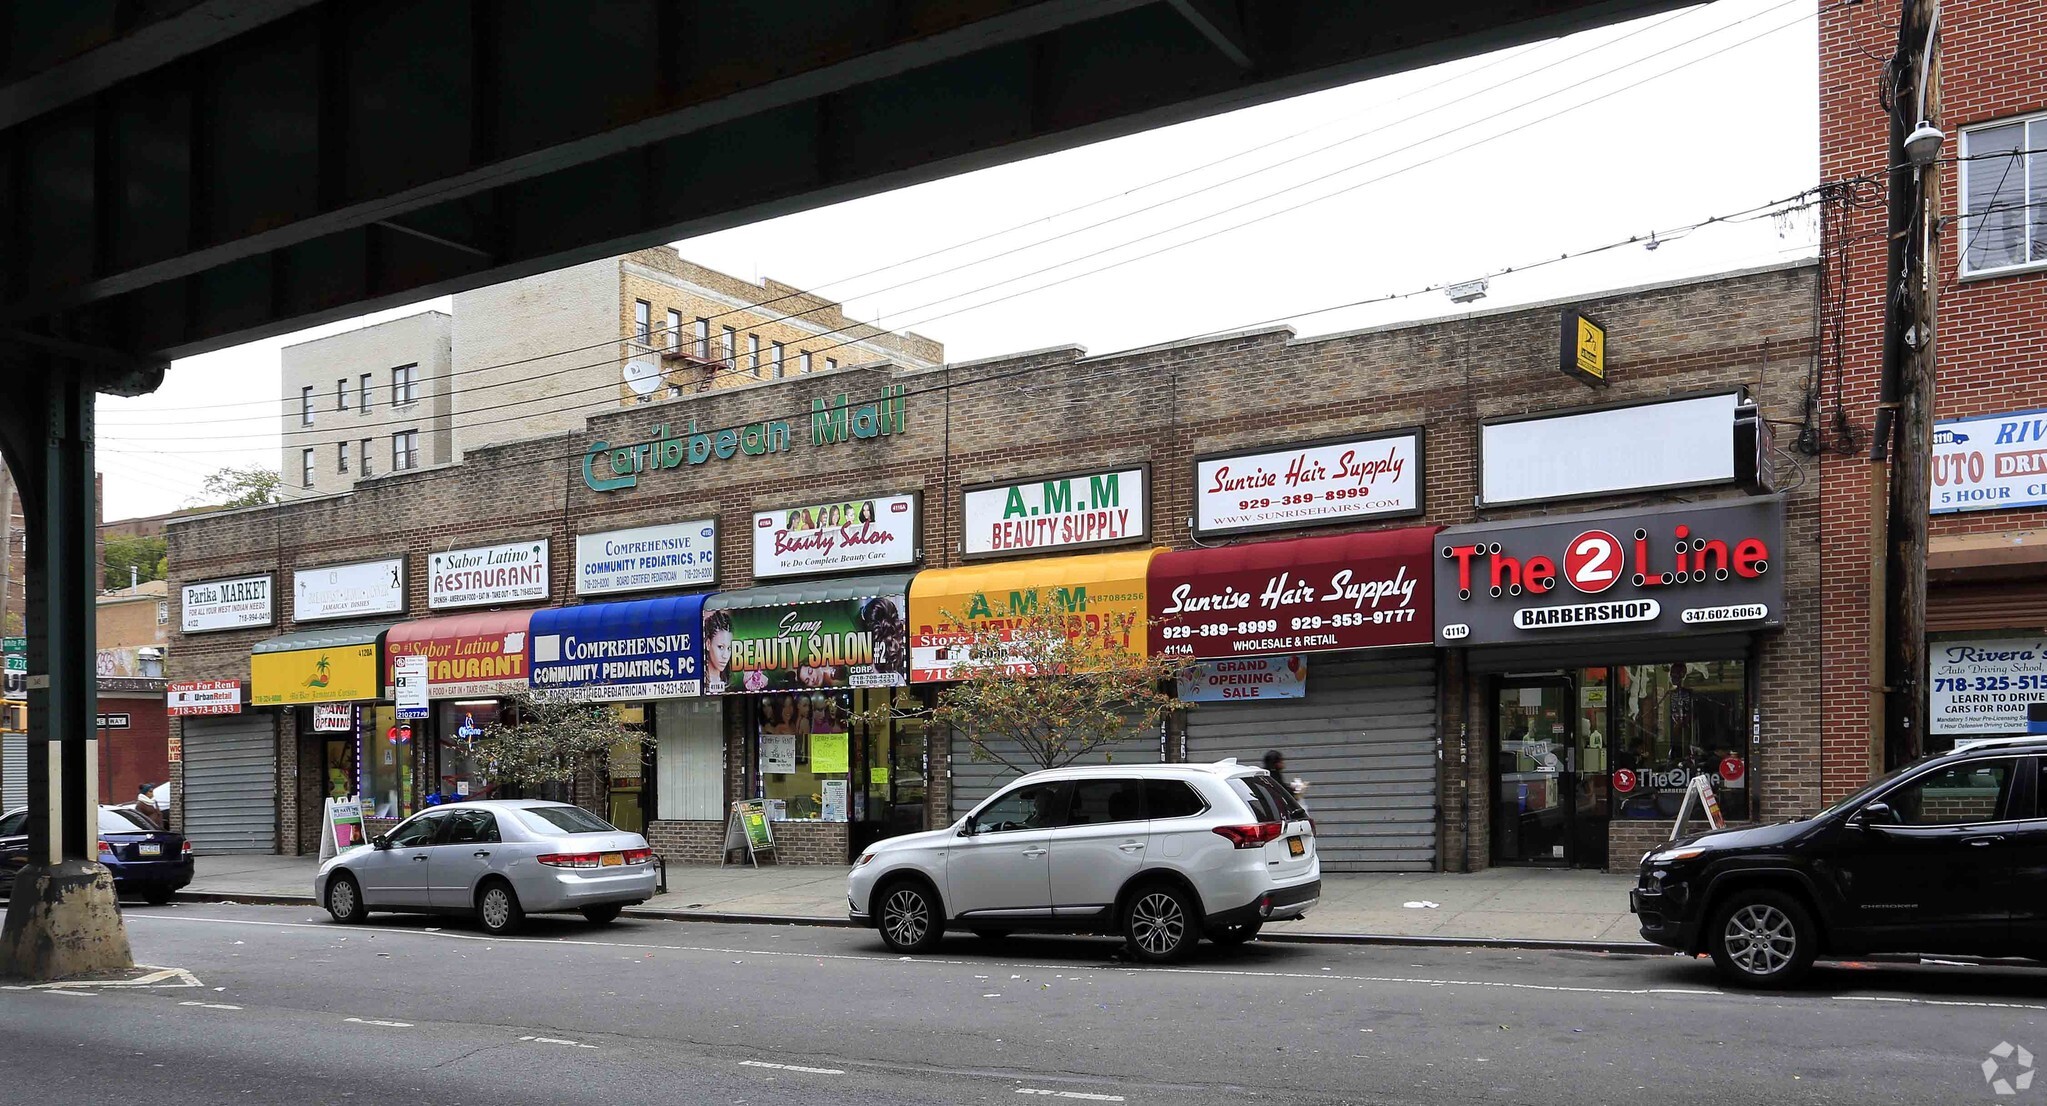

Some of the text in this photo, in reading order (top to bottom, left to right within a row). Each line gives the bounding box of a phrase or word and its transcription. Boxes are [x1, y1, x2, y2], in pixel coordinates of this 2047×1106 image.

[582, 384, 906, 492] Caribbean Mall
[1207, 447, 1405, 494] Sunrise Hair Supply
[1932, 451, 1985, 487] UTO
[1003, 474, 1118, 519] A.M.M
[1238, 487, 1369, 510] 929-389-8999
[1941, 491, 1951, 503] 5
[1957, 487, 2011, 502] HOUR
[1213, 499, 1401, 525] WWW.SUNRISEHAIRS.COM
[774, 519, 894, 556] Beauty Salon
[992, 509, 1129, 549] BEAUTY SUPPLY
[605, 537, 691, 556] COMPREHENSIVE
[447, 548, 528, 569] Sabor Latino
[585, 550, 712, 575] COMMUNITY PEDIATRICS, PC
[780, 551, 886, 568] We Do Complete Beauty Care
[1442, 524, 1769, 601] The 2 Line
[434, 564, 542, 593] RESTAURANT
[188, 580, 267, 604] Parika MARKET
[1162, 566, 1417, 614] Sunrise Hair Supply
[232, 604, 248, 612] INDIAN
[249, 602, 265, 610] NEEDS
[322, 600, 370, 611] JAMAICAN DISHES
[968, 587, 1144, 619] A.MM 87085256
[1521, 602, 1762, 626] BARBERSHOP 347.602.6064
[778, 612, 823, 640] Samy
[1163, 609, 1416, 639] 929-389-8999 929-353-9777
[1444, 625, 1466, 637] 4114
[403, 643, 412, 652] #1
[413, 641, 451, 657] Sabor
[455, 637, 499, 656] Latino
[565, 634, 690, 660] COMPREHENSIVE
[920, 634, 966, 647] Store
[1164, 644, 1193, 655] 4114A
[1233, 634, 1338, 652] WHOLESALE & RETAIL
[731, 631, 886, 672] BEAUTY SALON #2
[390, 654, 523, 682] TAURANT
[534, 657, 695, 684] COMMUNITY PEDIATRICS, PC
[850, 666, 874, 674] CORP.
[1216, 660, 1268, 672] GRAND
[1938, 664, 1965, 675] Auto
[1968, 664, 2007, 675] Driving
[196, 682, 212, 690] For
[215, 681, 235, 689] Rent
[398, 678, 405, 687] 2
[653, 681, 695, 696] 718-231-8200
[1208, 673, 1274, 686] OPENING
[194, 692, 232, 701] UrbanRetail
[432, 686, 445, 695] FOOD
[448, 685, 458, 695] EAT
[459, 685, 463, 694] IN
[466, 684, 477, 694] TAKE
[1222, 687, 1259, 698] SALE
[1952, 692, 2045, 704] LEARN TO DRIVE
[173, 705, 234, 715] 718-373-0333
[1945, 704, 2025, 714] CARS FOR ROAD
[1636, 769, 1668, 787] The
